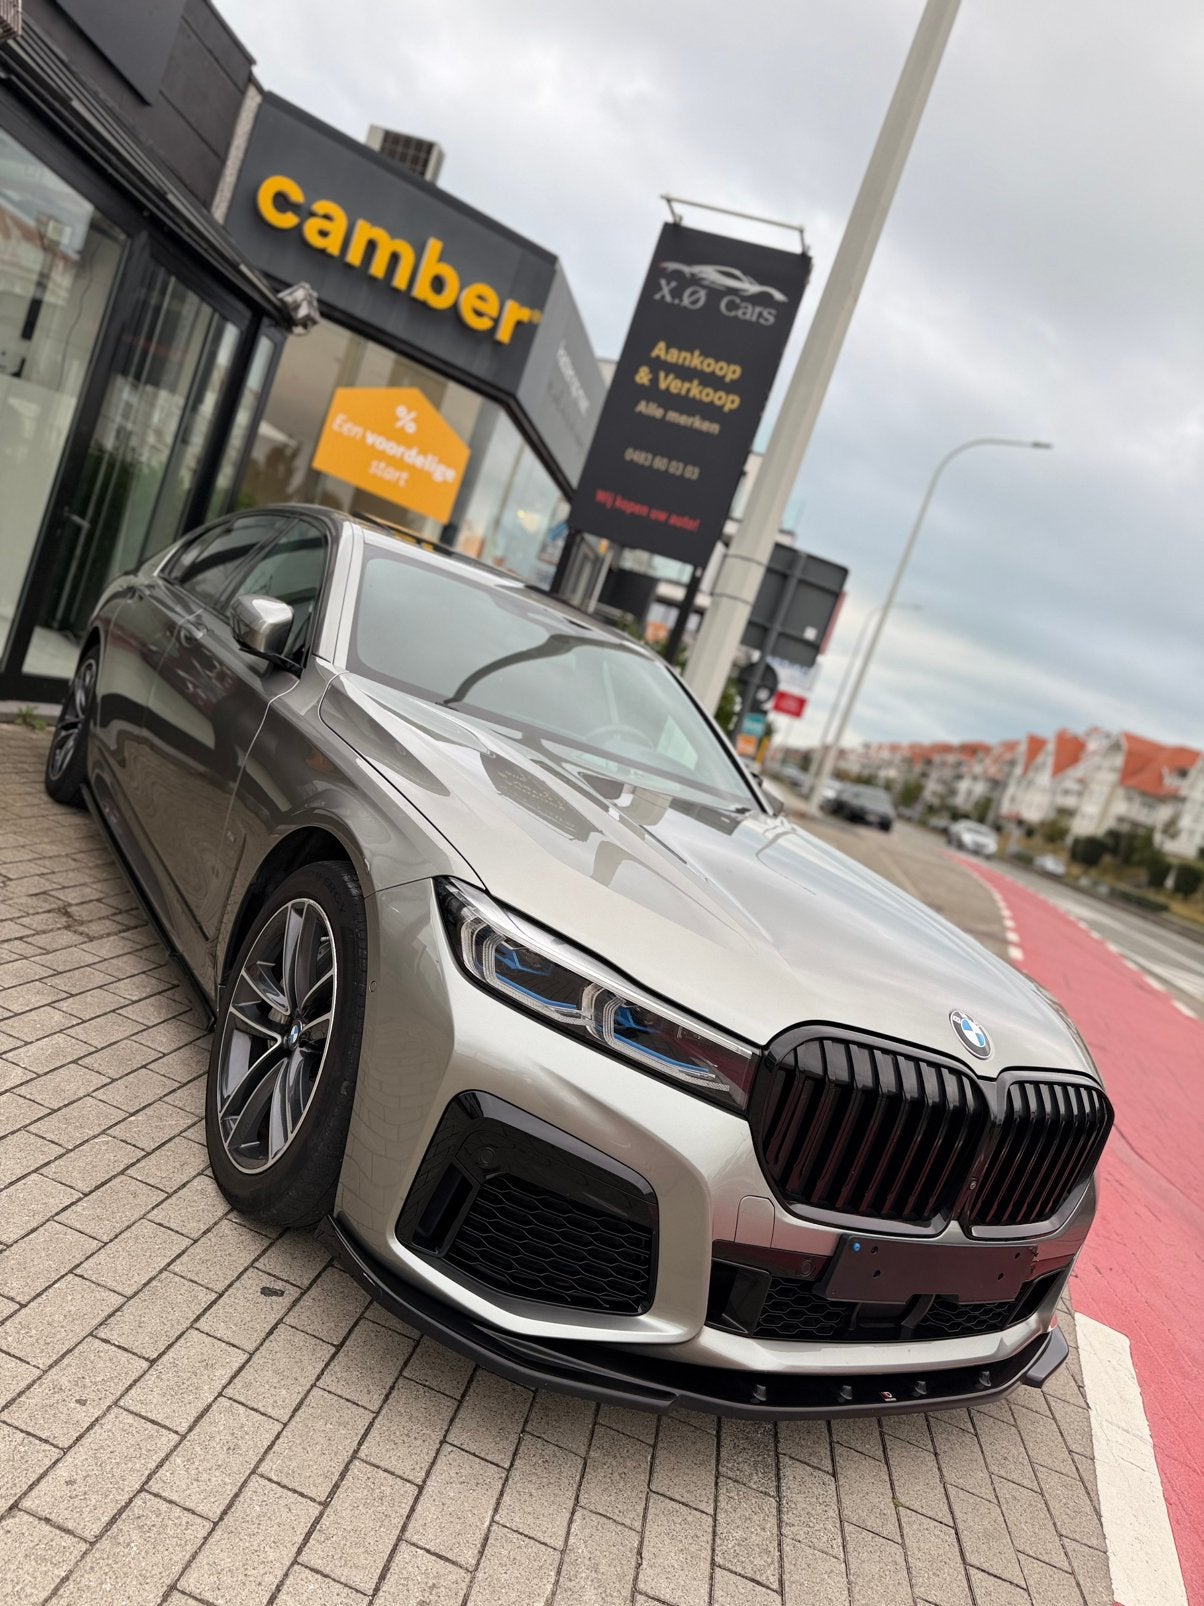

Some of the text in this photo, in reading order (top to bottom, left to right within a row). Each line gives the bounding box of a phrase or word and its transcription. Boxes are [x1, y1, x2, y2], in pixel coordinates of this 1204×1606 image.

[257, 174, 532, 344] camber
[720, 295, 777, 326] Cars
[650, 340, 742, 383] Aankoop
[634, 365, 740, 413] & Verkoop
[395, 405, 417, 434] %
[634, 400, 720, 435] Alle merken
[332, 414, 456, 483] Een voordelige
[369, 460, 409, 487] start
[595, 489, 615, 509] Wij
[614, 495, 649, 516] kopen
[649, 508, 669, 522] uw
